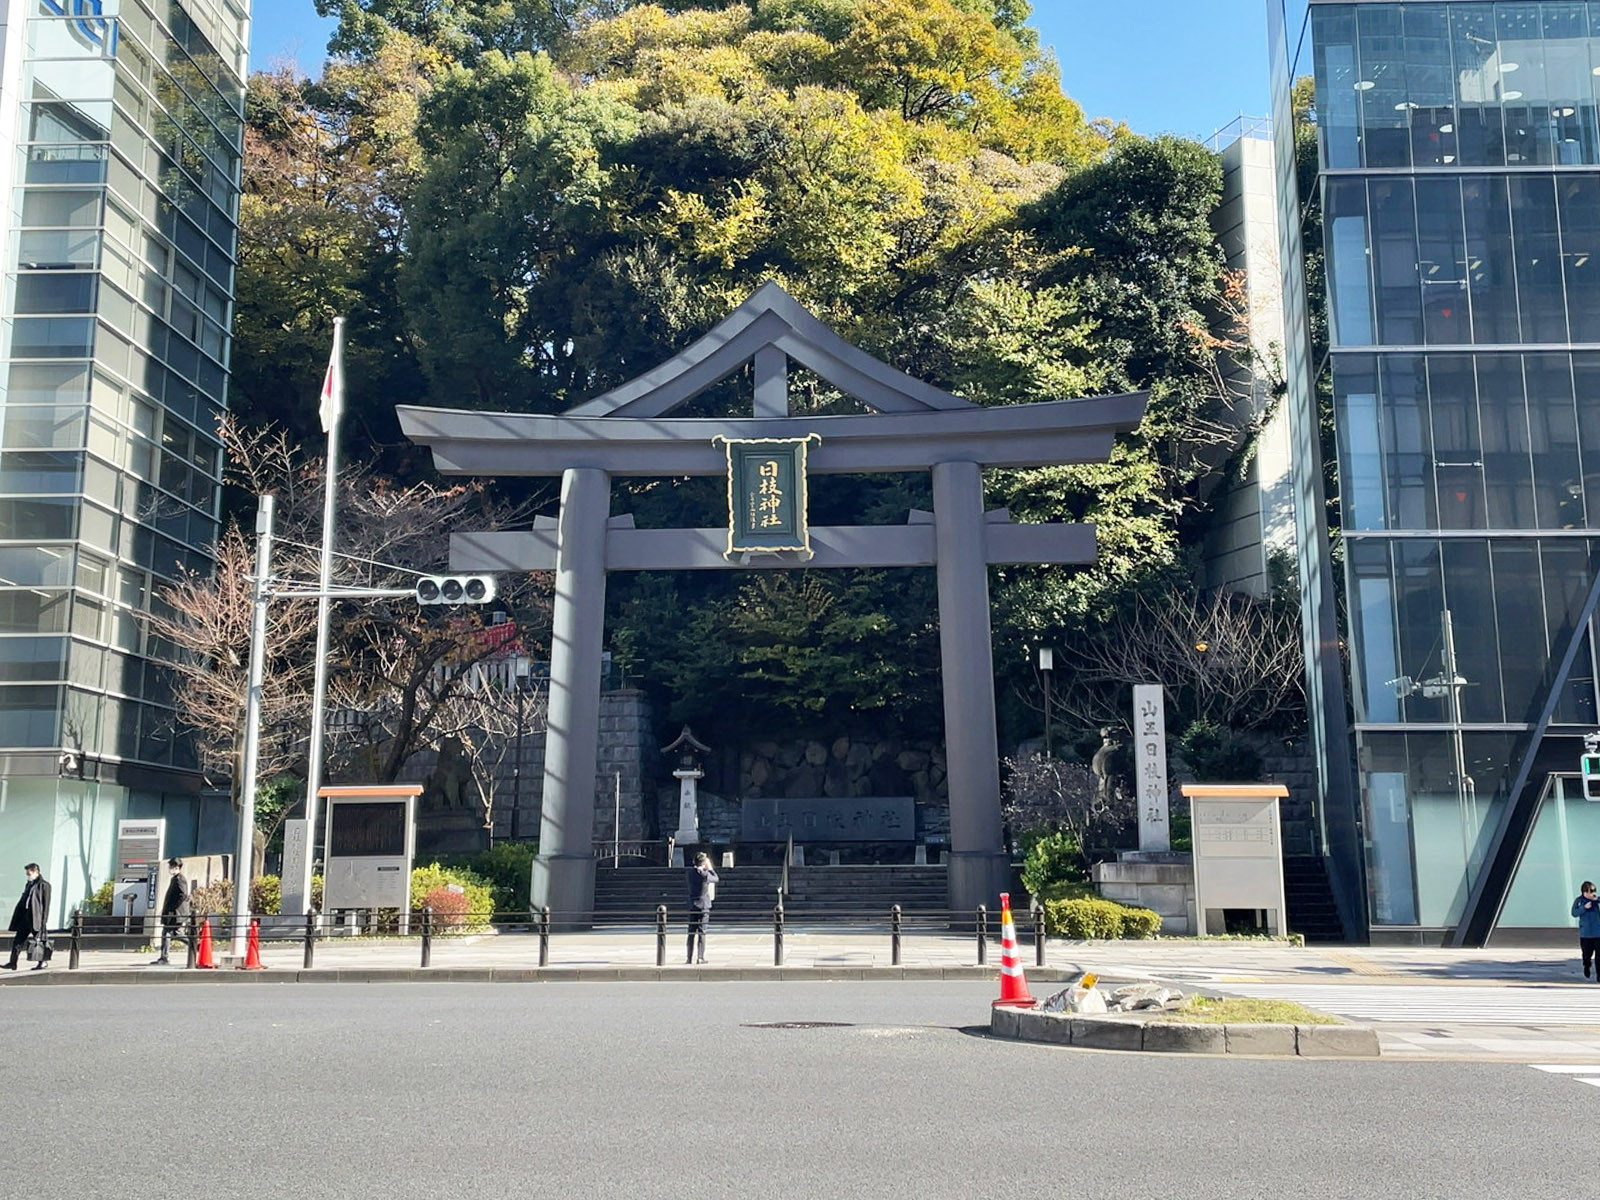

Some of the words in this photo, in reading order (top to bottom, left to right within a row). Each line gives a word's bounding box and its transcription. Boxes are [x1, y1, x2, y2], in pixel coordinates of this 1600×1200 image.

[760, 461, 782, 527] 日枝神社
[1141, 700, 1163, 823] 山王日枝神社
